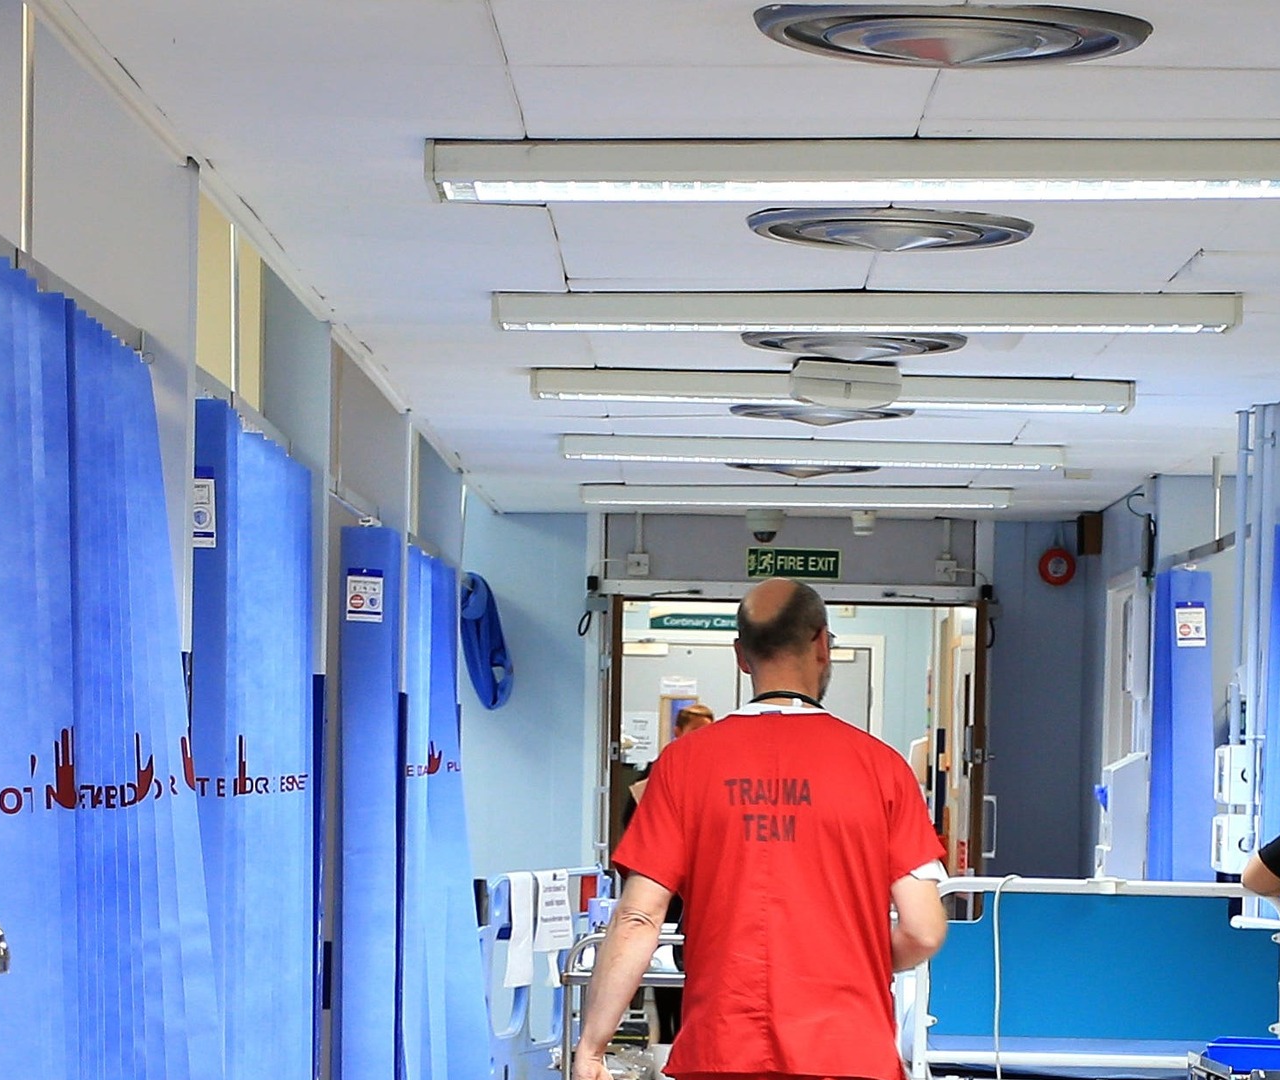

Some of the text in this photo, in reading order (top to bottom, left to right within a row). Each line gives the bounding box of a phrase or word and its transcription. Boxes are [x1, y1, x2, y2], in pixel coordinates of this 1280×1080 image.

[777, 556, 836, 571] FIRE EXIT
[724, 778, 812, 806] TRAUMA
[743, 813, 796, 842] TEAM
